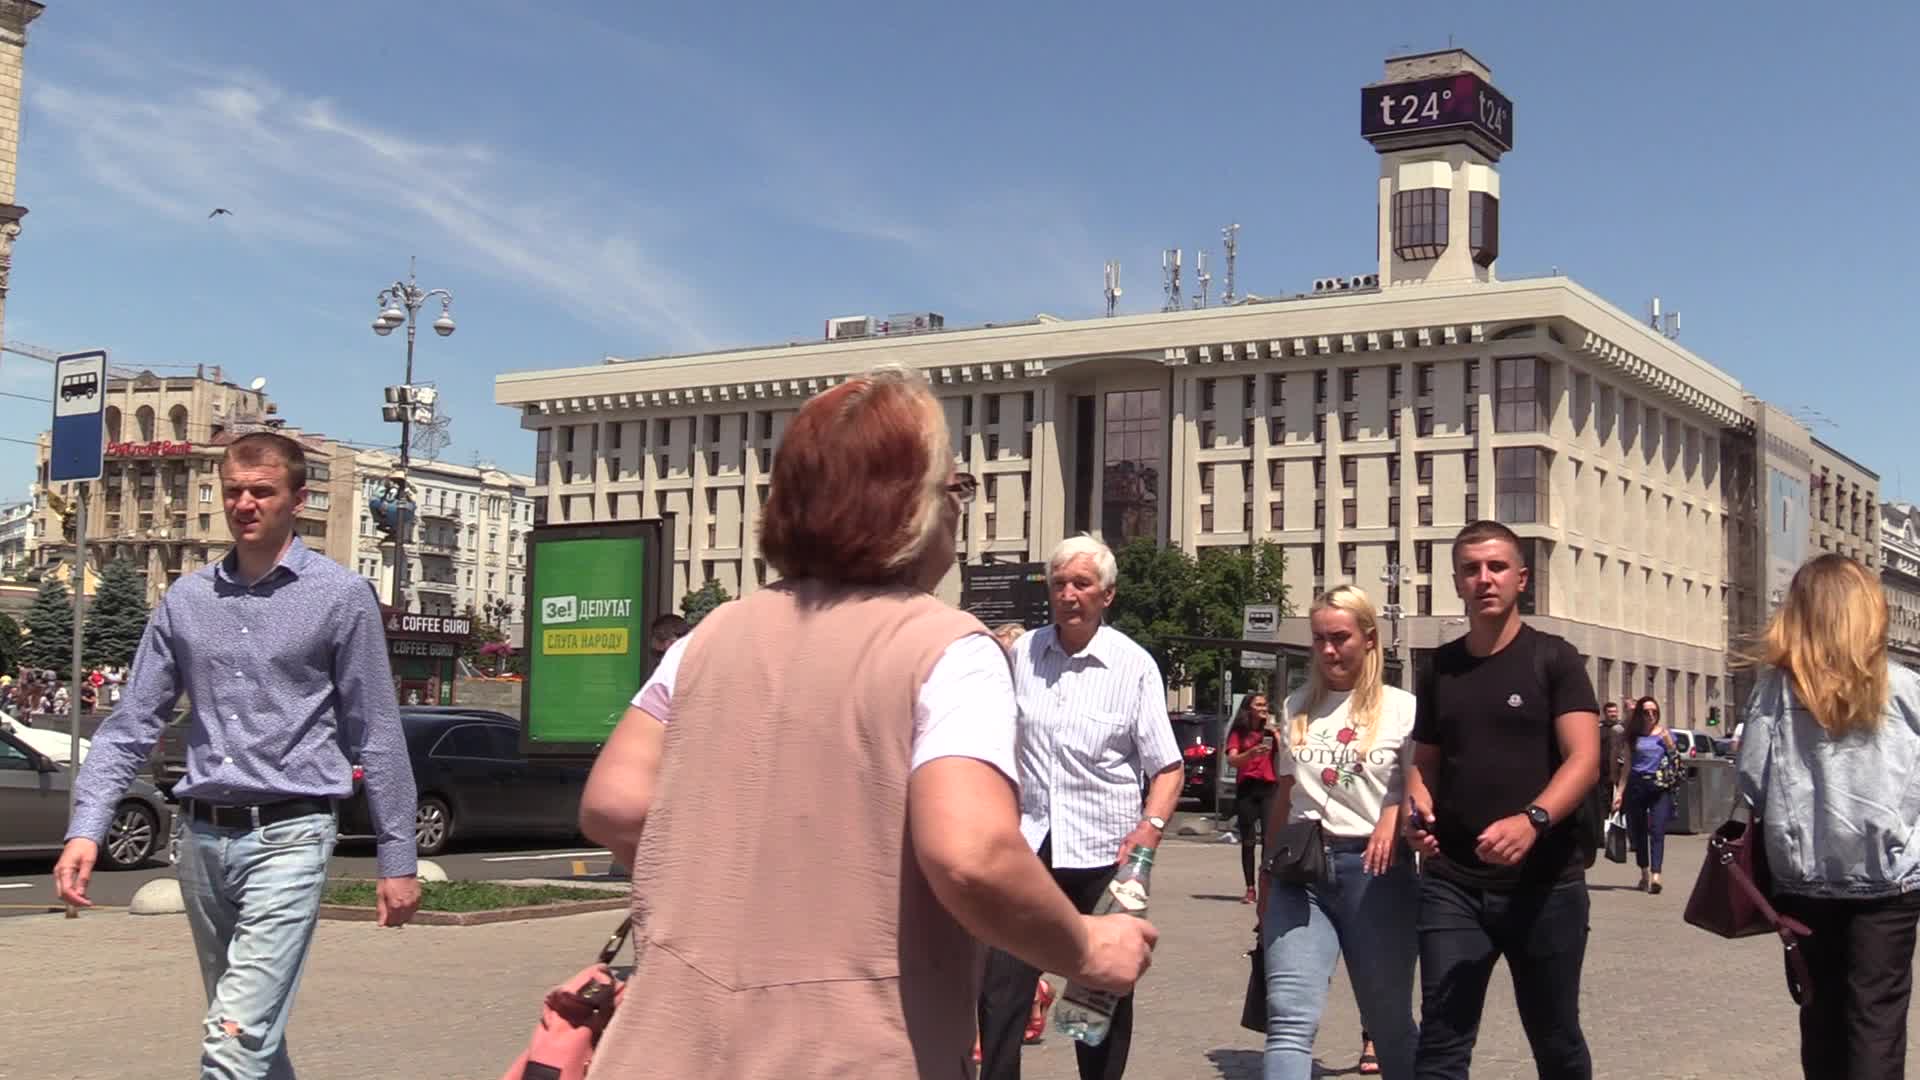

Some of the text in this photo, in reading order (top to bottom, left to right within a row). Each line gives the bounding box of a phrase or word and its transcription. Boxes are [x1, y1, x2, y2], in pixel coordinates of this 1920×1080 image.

[579, 599, 632, 620] ДЕПУТАТ
[402, 616, 470, 634] COFFEE GURU
[393, 641, 454, 656] COFFEE GURU
[547, 632, 623, 649] СЛУГА НАРОДУ
[1294, 747, 1385, 766] OTHING
